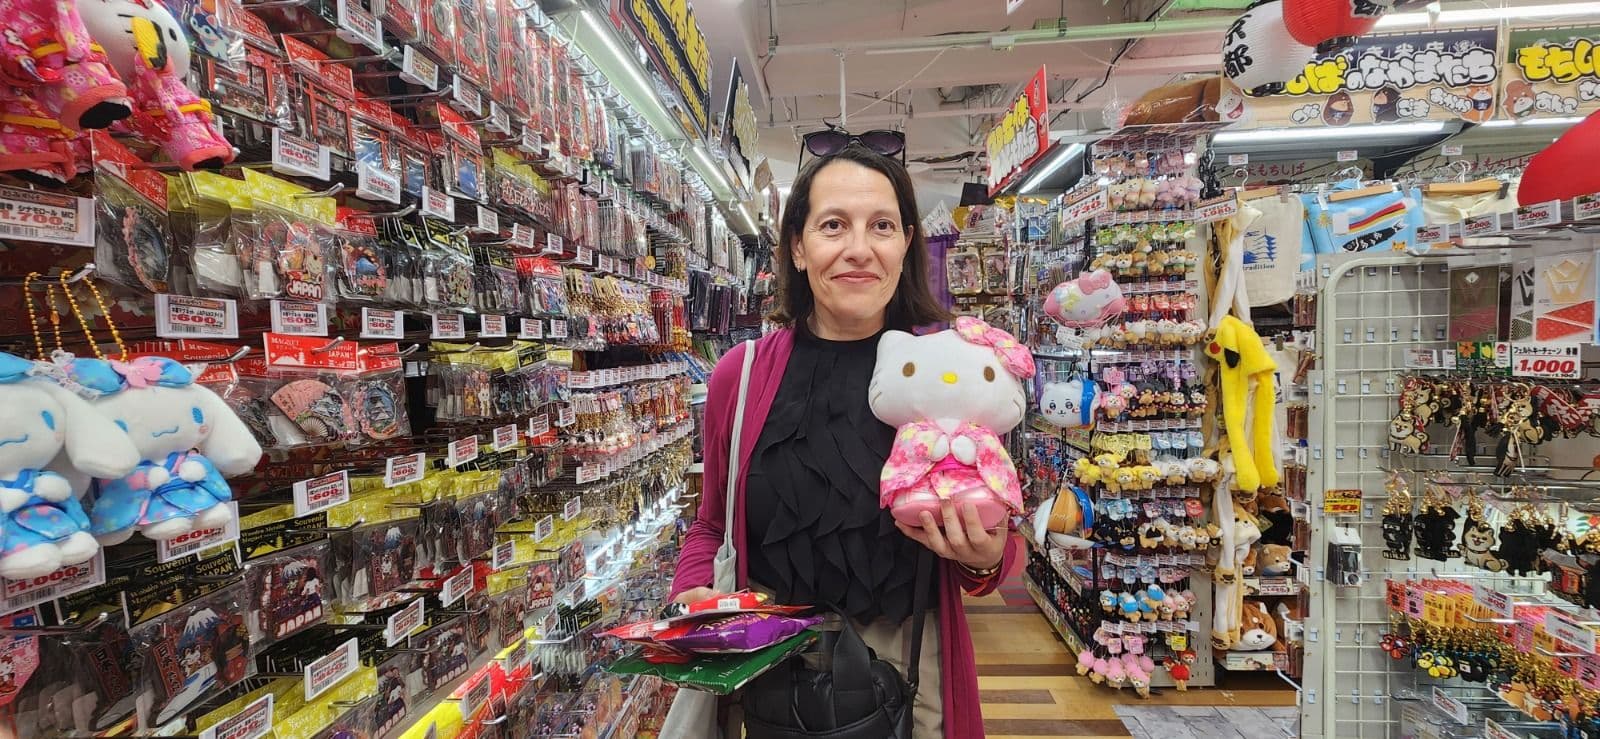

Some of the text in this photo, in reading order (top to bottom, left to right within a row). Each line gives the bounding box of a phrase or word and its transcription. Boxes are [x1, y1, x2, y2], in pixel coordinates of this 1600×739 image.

[1243, 50, 1496, 95] しばのなかまたち
[1398, 98, 1429, 117] ごま
[1535, 91, 1578, 113] あんこ
[287, 279, 322, 298] JAPAN
[294, 514, 324, 527] Souvenir
[143, 555, 193, 576] Souvenir
[195, 554, 233, 574] Souvenir
[277, 605, 322, 639] JAPAN
[360, 631, 383, 645] Souve
[435, 662, 467, 690] JAPAN
